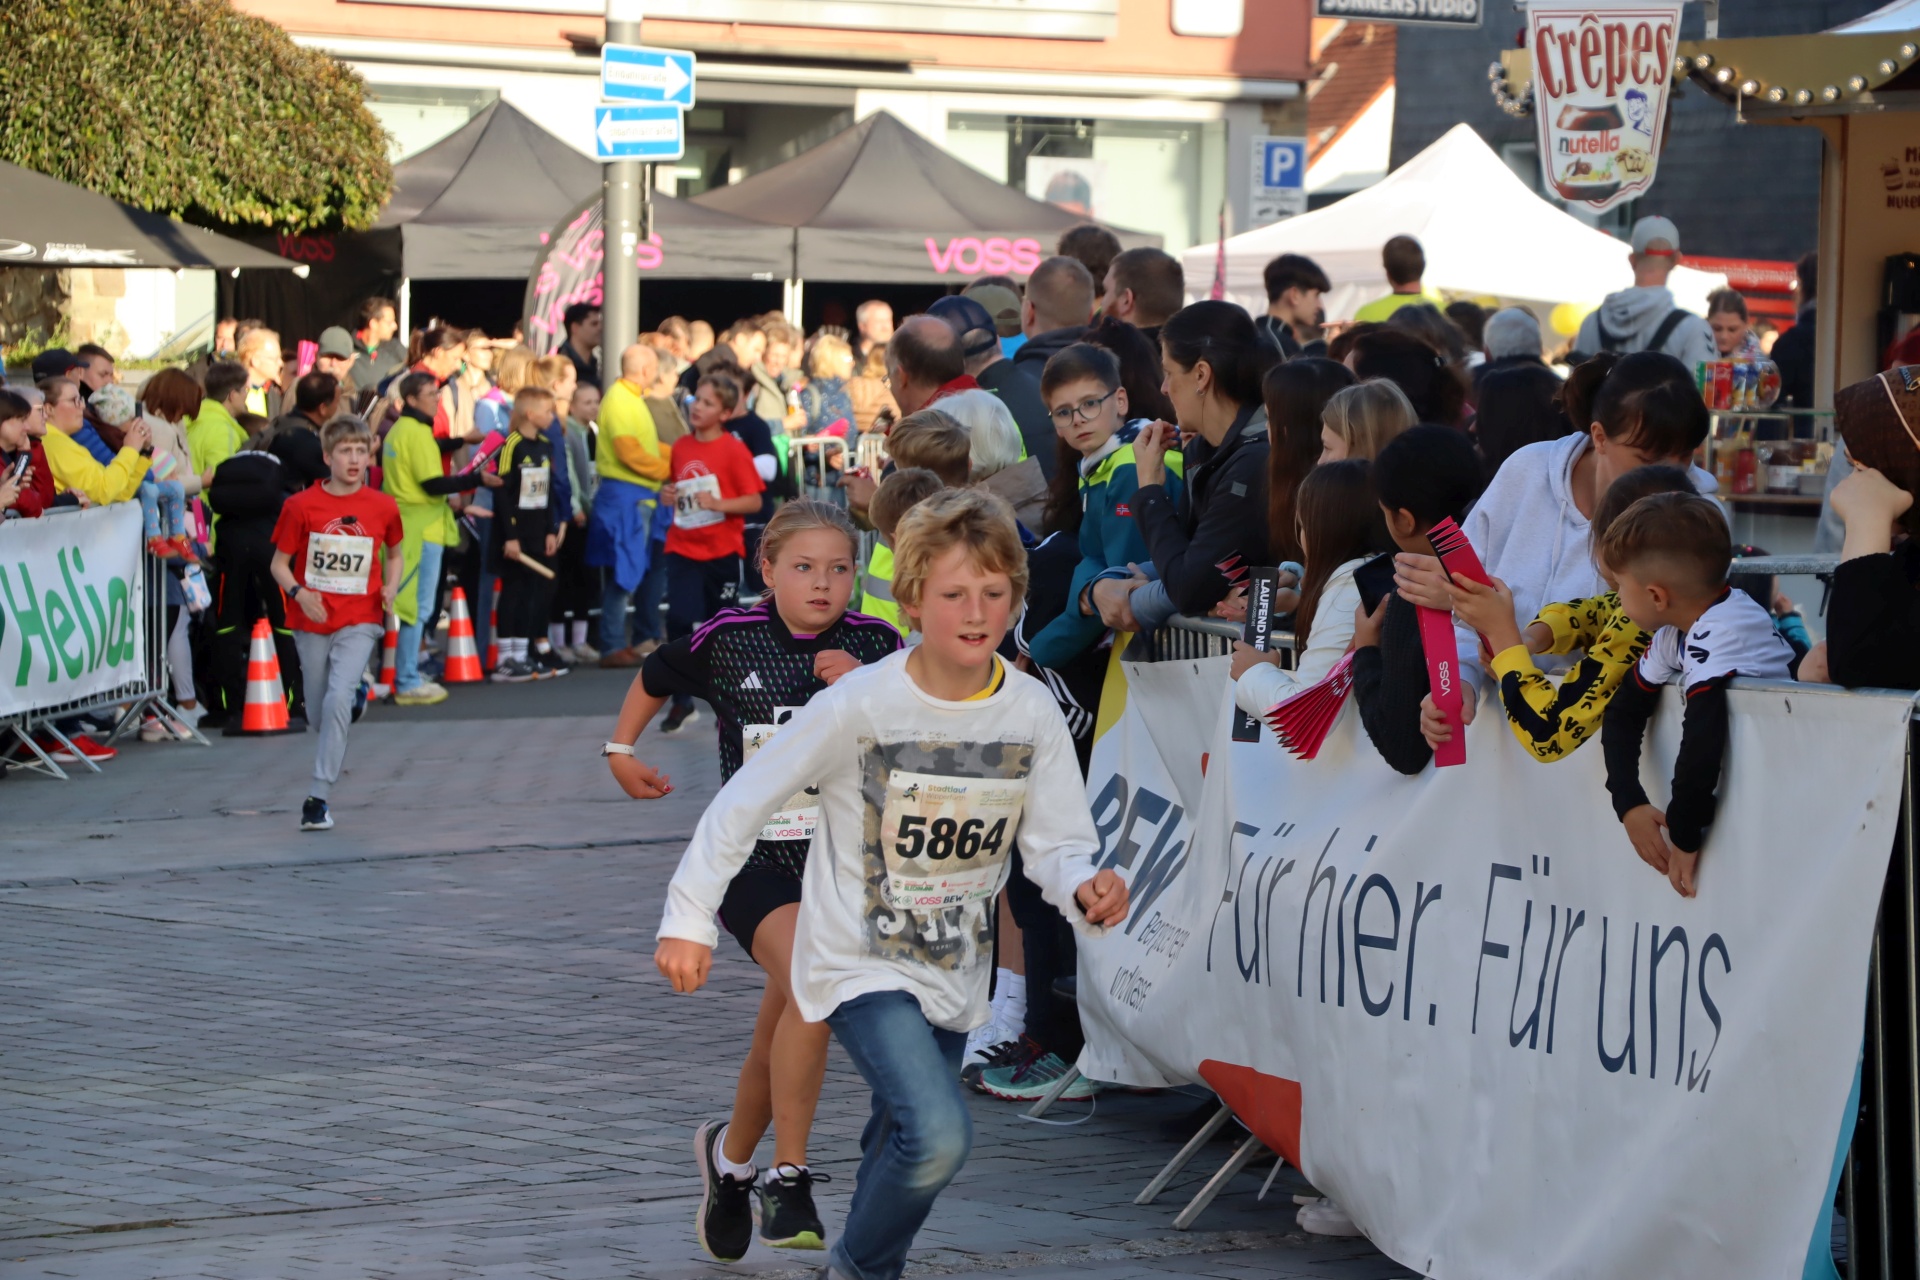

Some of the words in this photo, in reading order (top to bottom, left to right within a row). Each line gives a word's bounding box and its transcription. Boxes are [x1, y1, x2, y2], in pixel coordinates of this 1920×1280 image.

[1536, 13, 1672, 99] Crêpes
[1560, 130, 1620, 154] nutella
[1272, 147, 1296, 183] P
[924, 237, 1042, 275] VOSS
[313, 551, 364, 572] 5297
[1256, 579, 1271, 634] LAUFEND
[1439, 661, 1451, 697] VOSS
[926, 793, 966, 801] Wipperfürth
[928, 784, 967, 794] Stadtlauf
[775, 828, 803, 837] VOSS
[895, 815, 1008, 860] 5864
[914, 896, 942, 906] VOSS
[943, 894, 966, 904] BEW
[1207, 821, 1296, 987] Für
[1297, 827, 1442, 1026] hier.
[1472, 854, 1586, 1055] Für
[1597, 913, 1732, 1094] uns.
